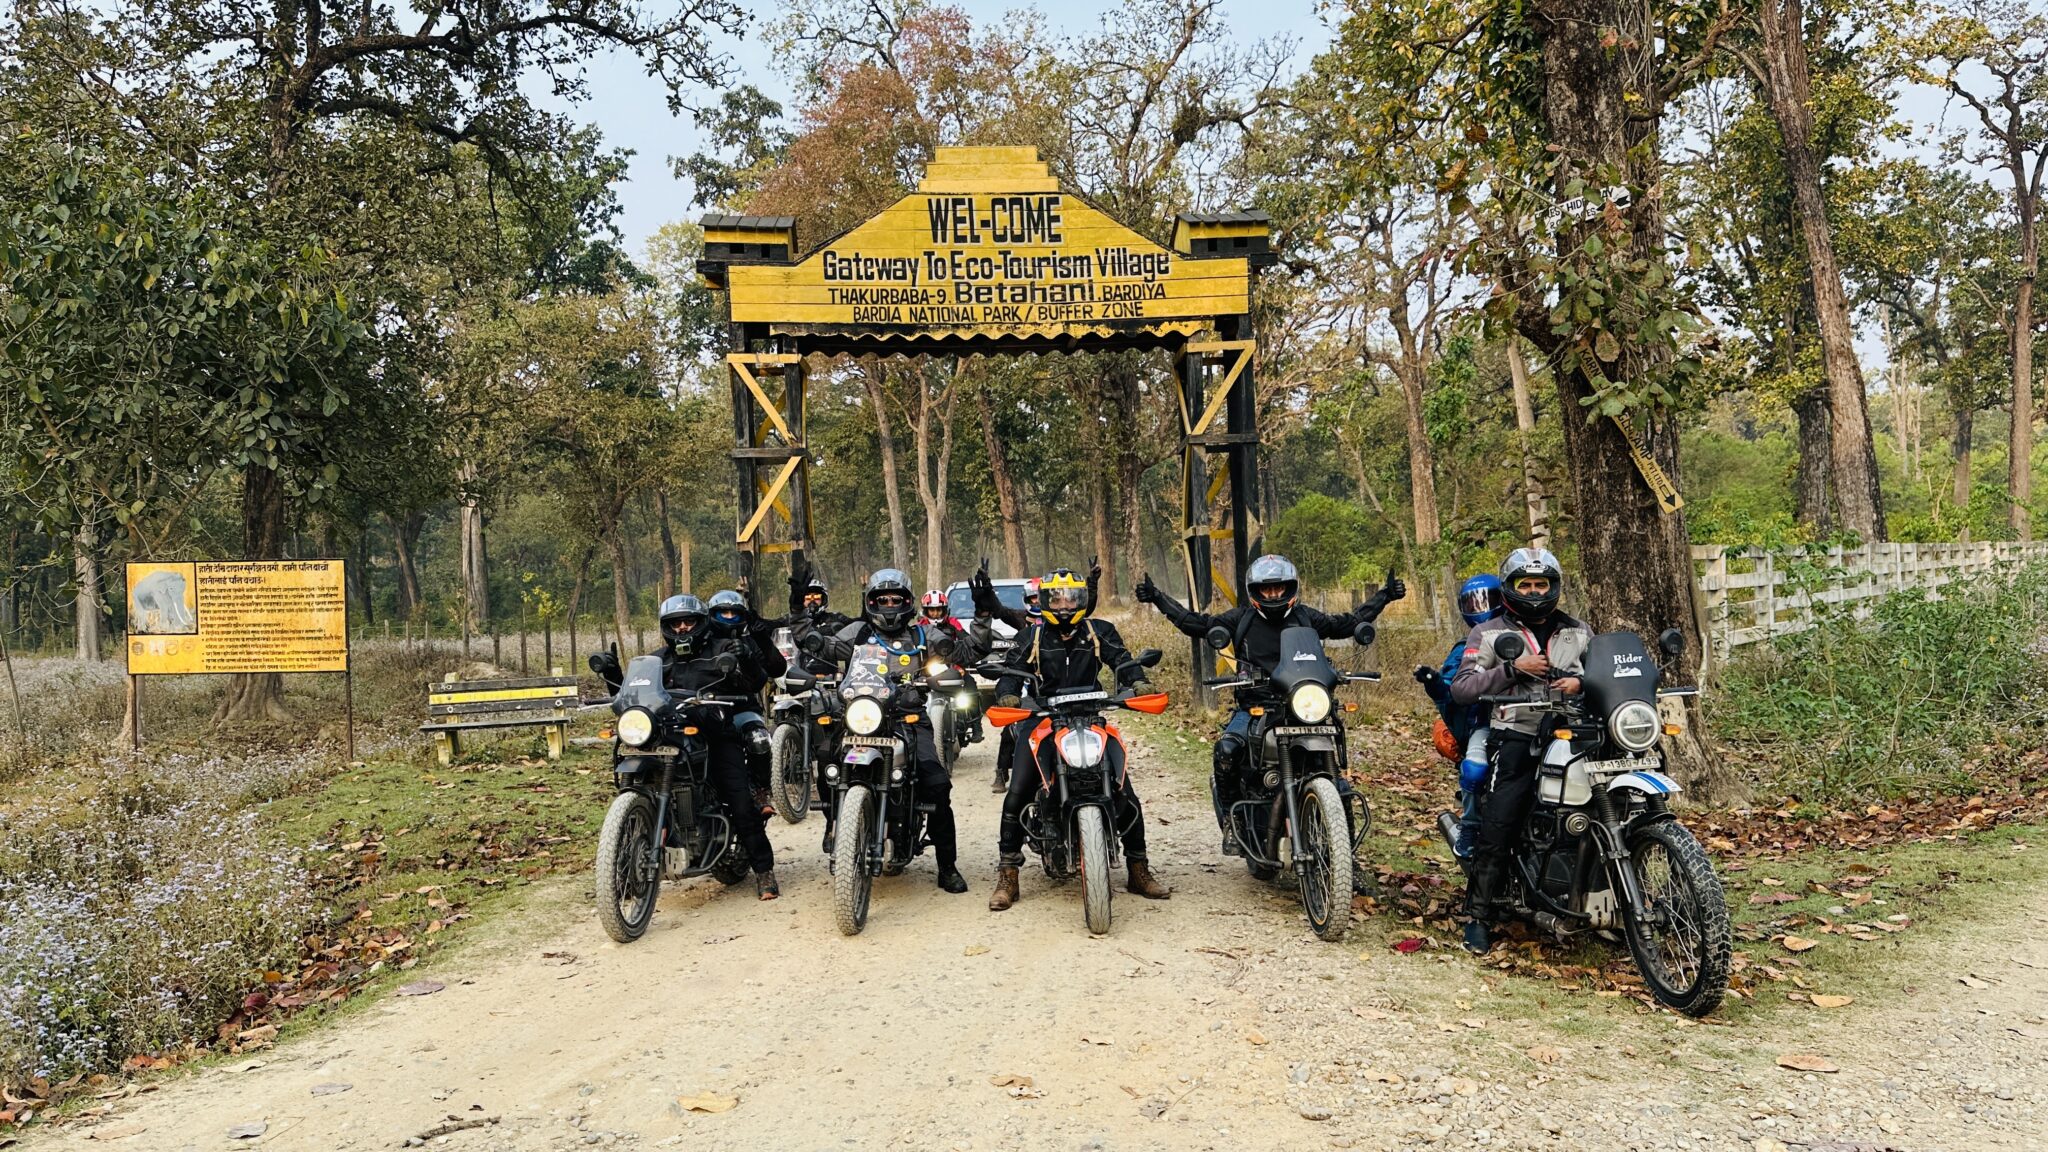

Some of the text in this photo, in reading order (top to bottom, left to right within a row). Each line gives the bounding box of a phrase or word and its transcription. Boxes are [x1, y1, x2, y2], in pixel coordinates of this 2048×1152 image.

[928, 197, 1061, 243] WEL-COME
[823, 247, 1170, 287] Gateway To Eco-Tourism Village
[1102, 283, 1166, 300] BARDIYA
[853, 306, 902, 322] BARDIA
[909, 305, 978, 322] NATIONAL
[984, 304, 1023, 322] PARK
[1038, 304, 1093, 320] BUFFER
[1101, 301, 1144, 318] ZONE
[1613, 653, 1643, 664] Rider
